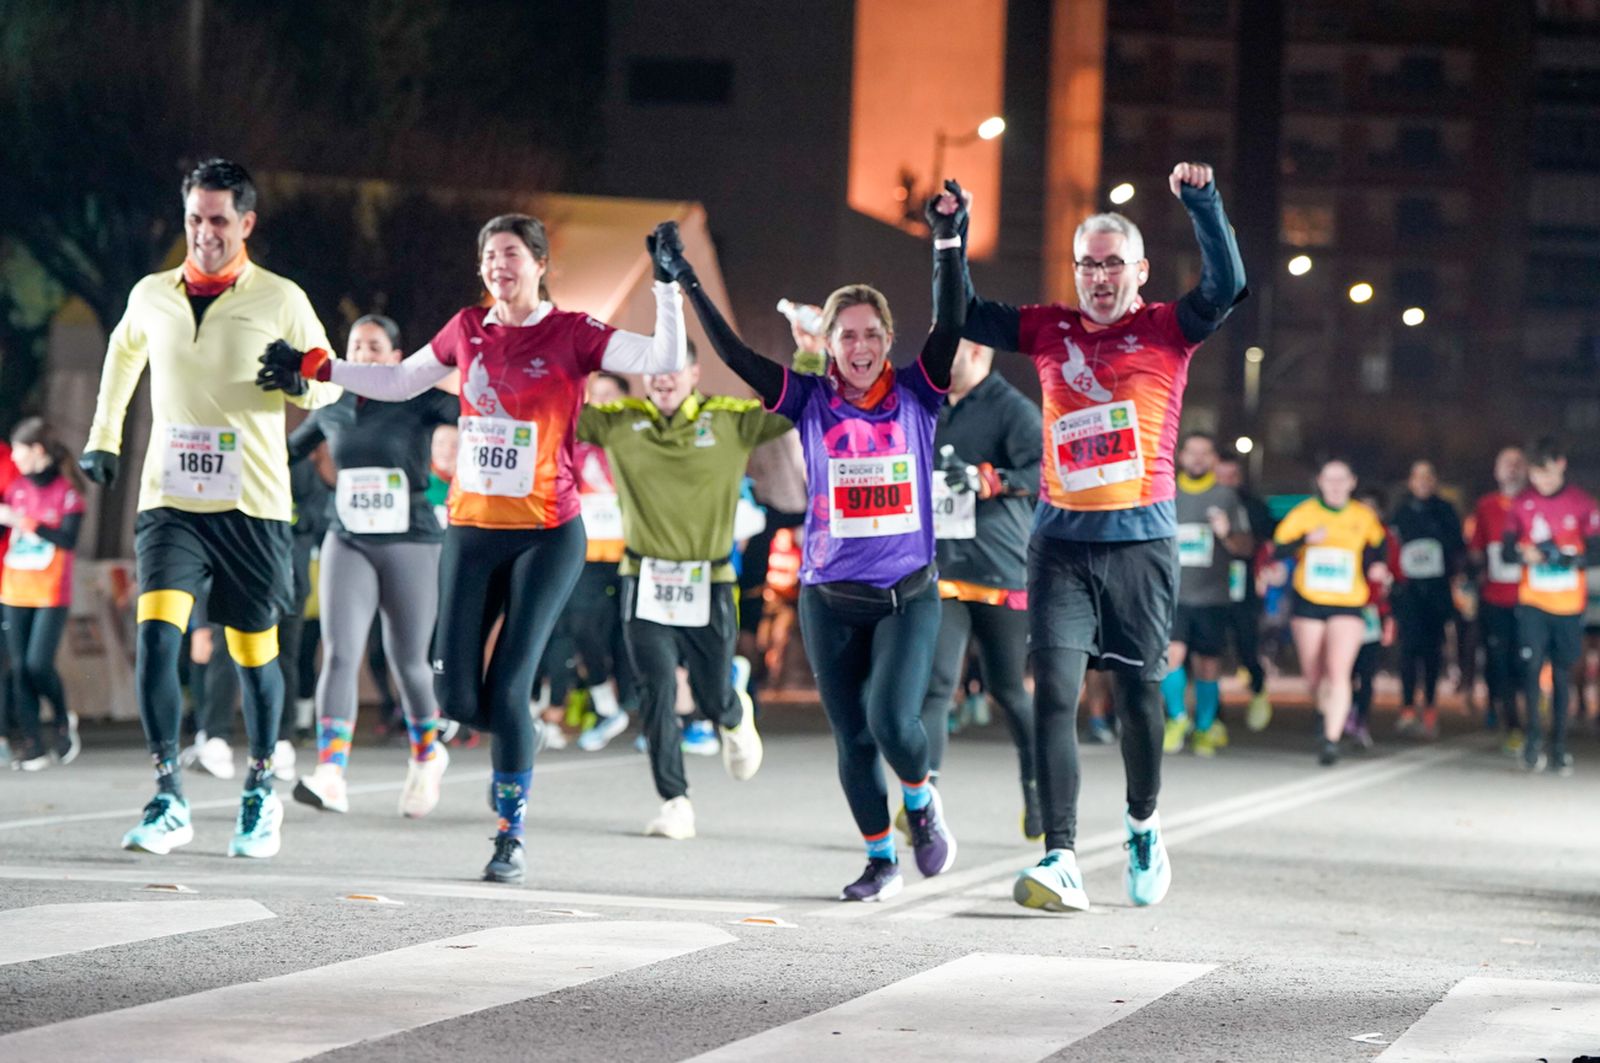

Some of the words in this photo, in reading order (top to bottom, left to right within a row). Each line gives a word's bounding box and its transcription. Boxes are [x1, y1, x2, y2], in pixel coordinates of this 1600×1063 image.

[1073, 372, 1093, 393] 43
[477, 393, 497, 415] 43
[178, 452, 224, 474] 1867
[473, 446, 518, 470] 1868
[350, 492, 394, 509] 4580
[848, 484, 900, 510] 9780
[935, 497, 954, 515] 20
[654, 583, 694, 602] 3876
